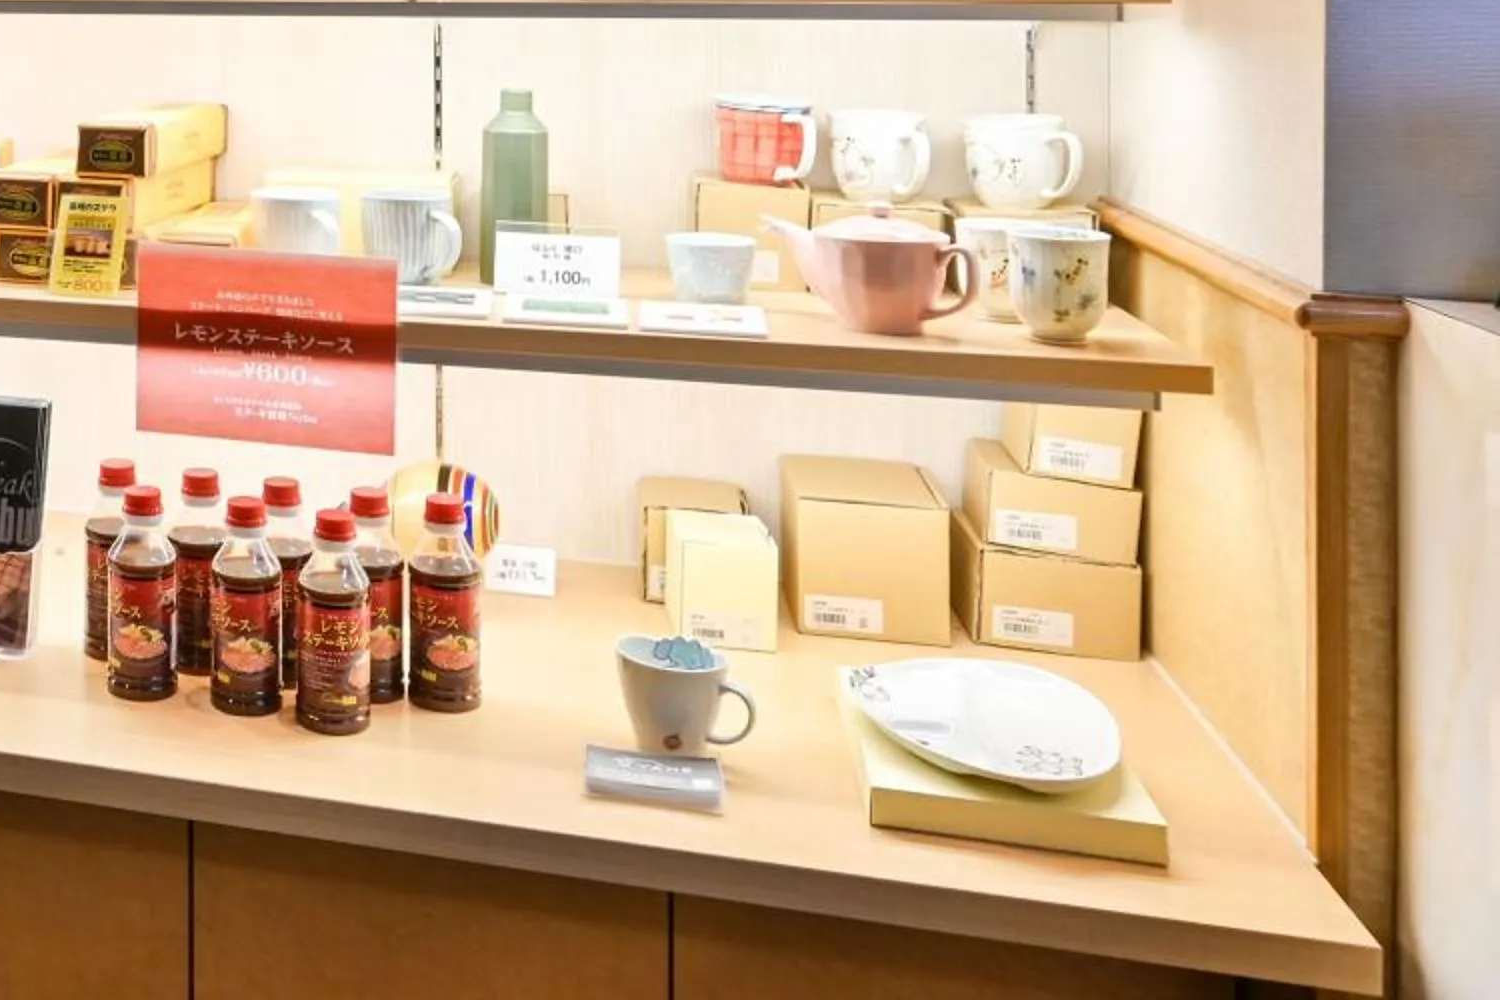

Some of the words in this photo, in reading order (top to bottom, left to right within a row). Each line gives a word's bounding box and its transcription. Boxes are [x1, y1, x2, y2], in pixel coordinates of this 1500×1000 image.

[172, 321, 356, 355] レモンステーキソース
